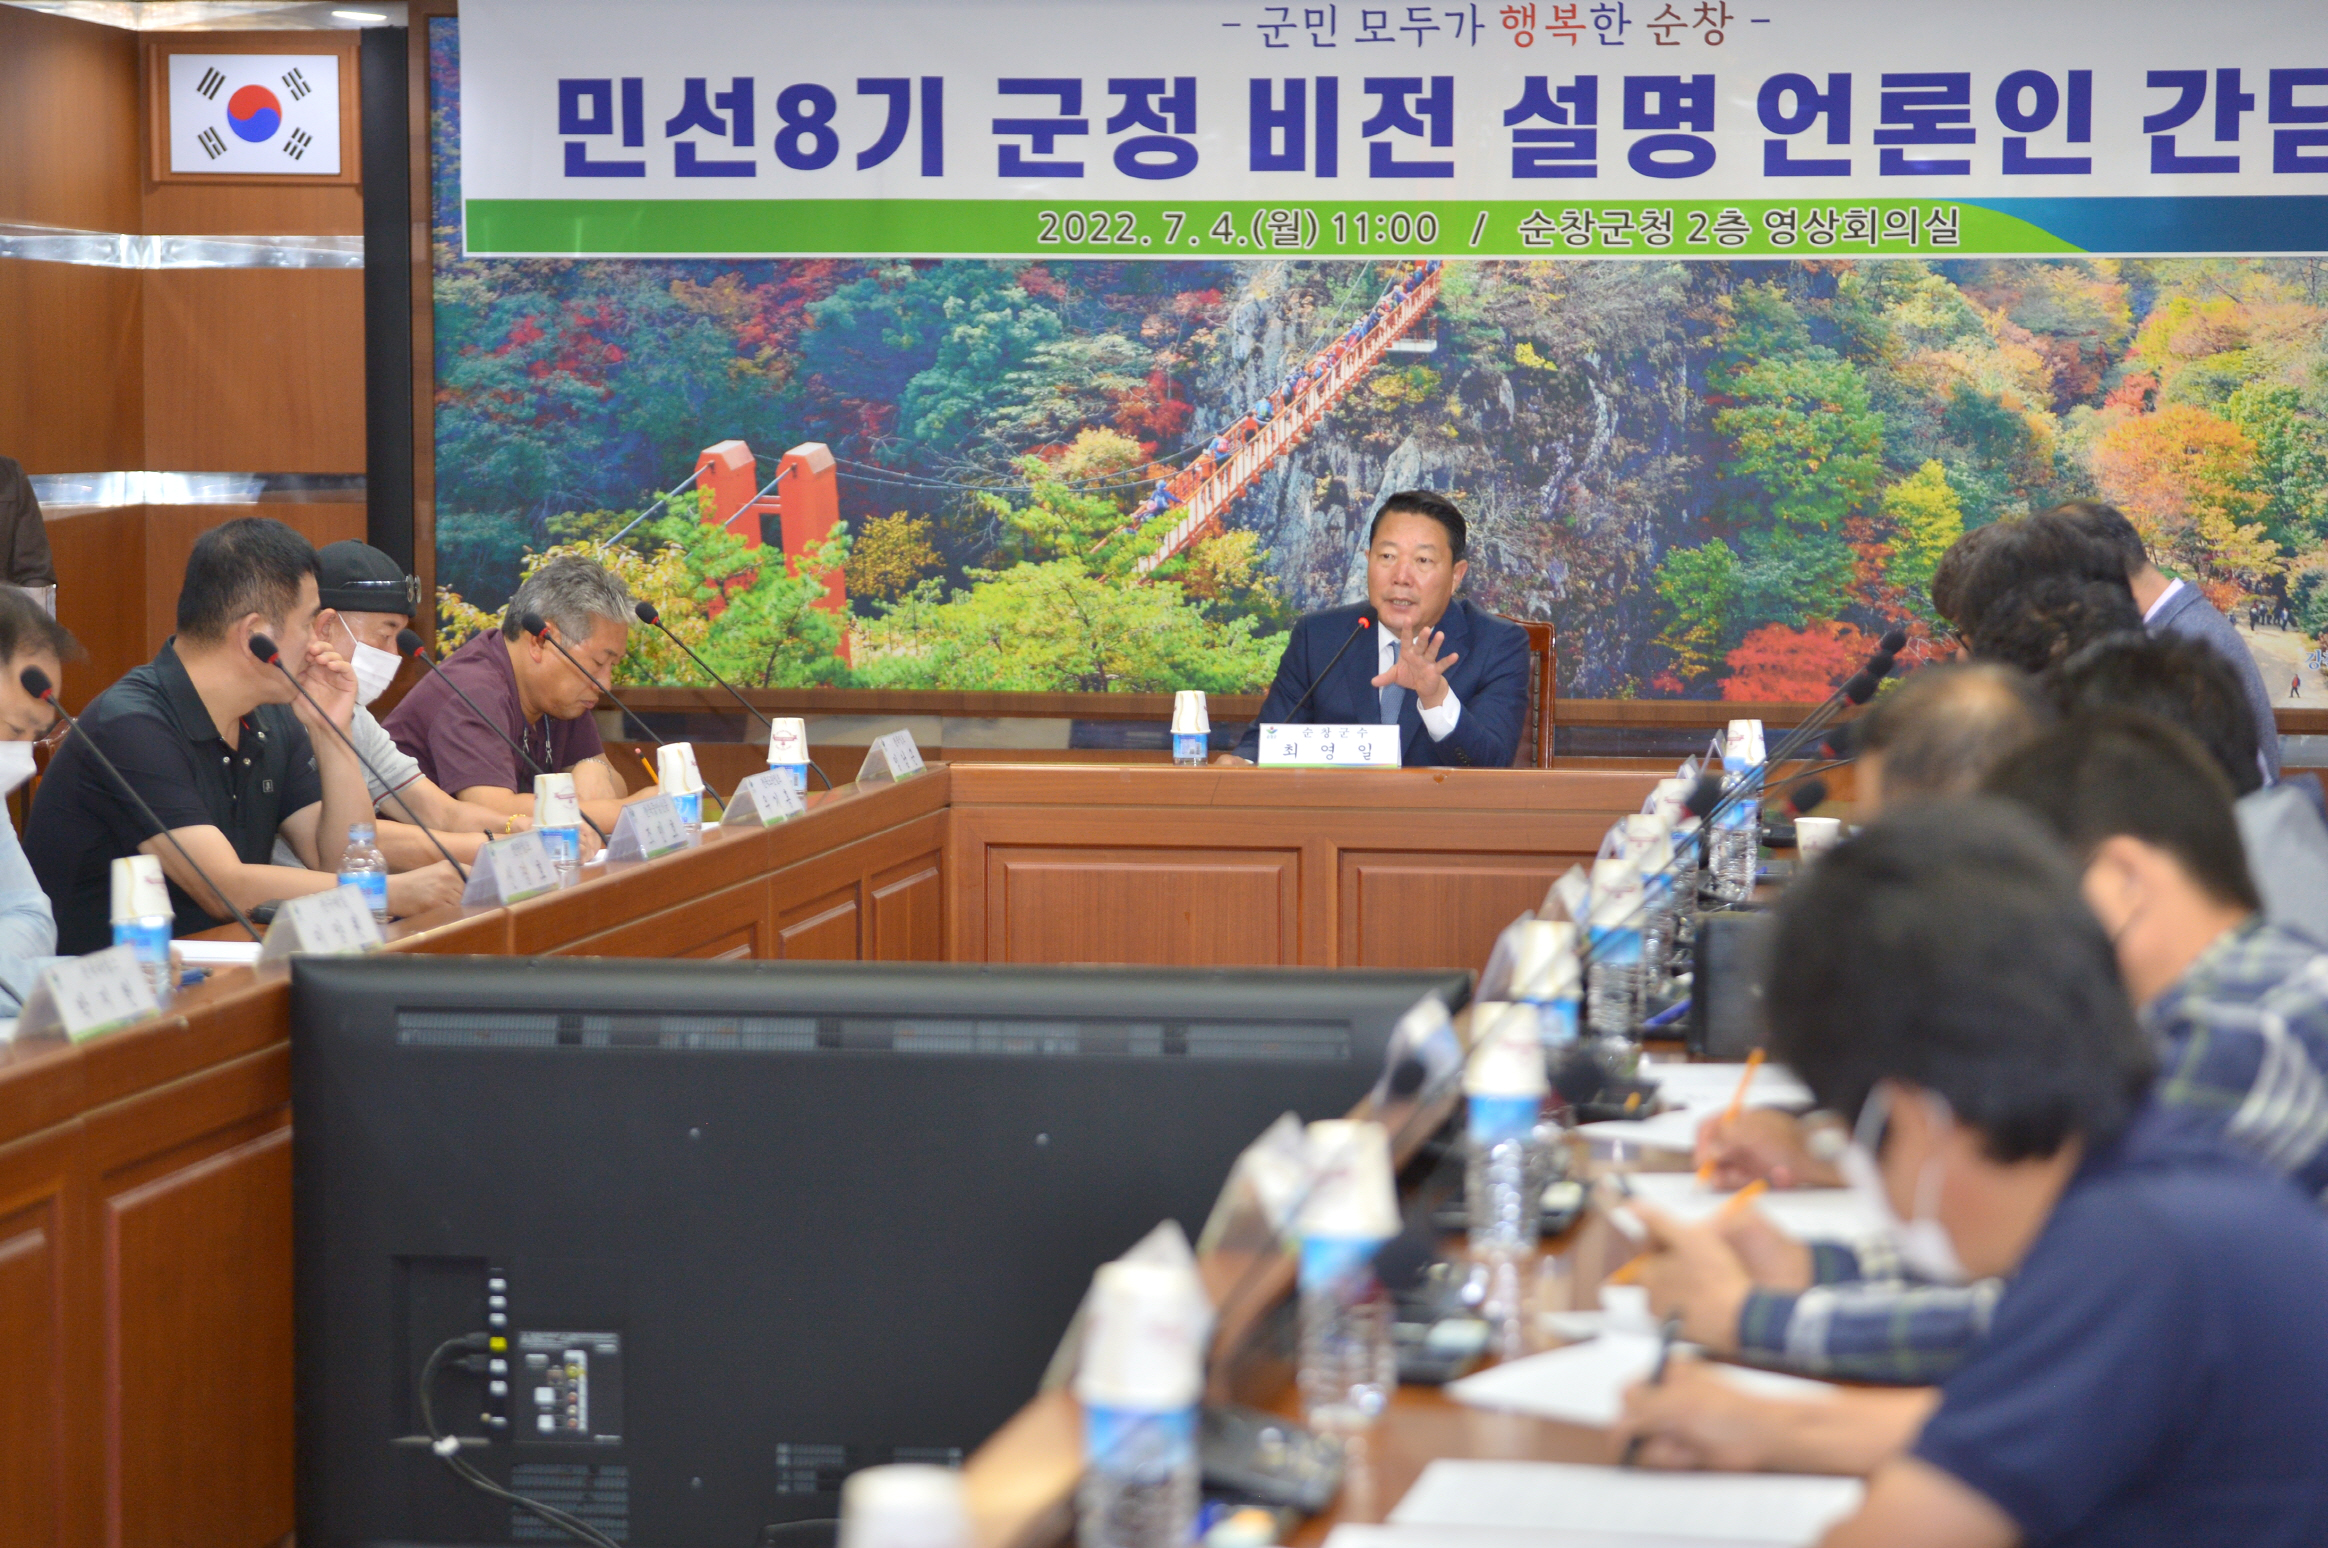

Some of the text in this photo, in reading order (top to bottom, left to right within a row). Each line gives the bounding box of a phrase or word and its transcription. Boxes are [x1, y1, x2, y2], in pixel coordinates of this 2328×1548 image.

[1256, 3, 1338, 48] 군민
[1354, 2, 1486, 48] 모두가
[1499, 1, 1633, 48] 행복한
[1646, 0, 1735, 47] 순창
[558, 76, 944, 178] 민선8기
[992, 76, 1199, 180] 군정
[1249, 75, 1454, 178] 비전
[1503, 74, 1717, 179] 설명
[1756, 69, 2093, 177] 언론인
[1333, 212, 1438, 244] 11:00
[1519, 209, 1672, 247] 순창군청
[1687, 209, 1751, 246] 2층
[1764, 208, 1959, 247] 영상회의실
